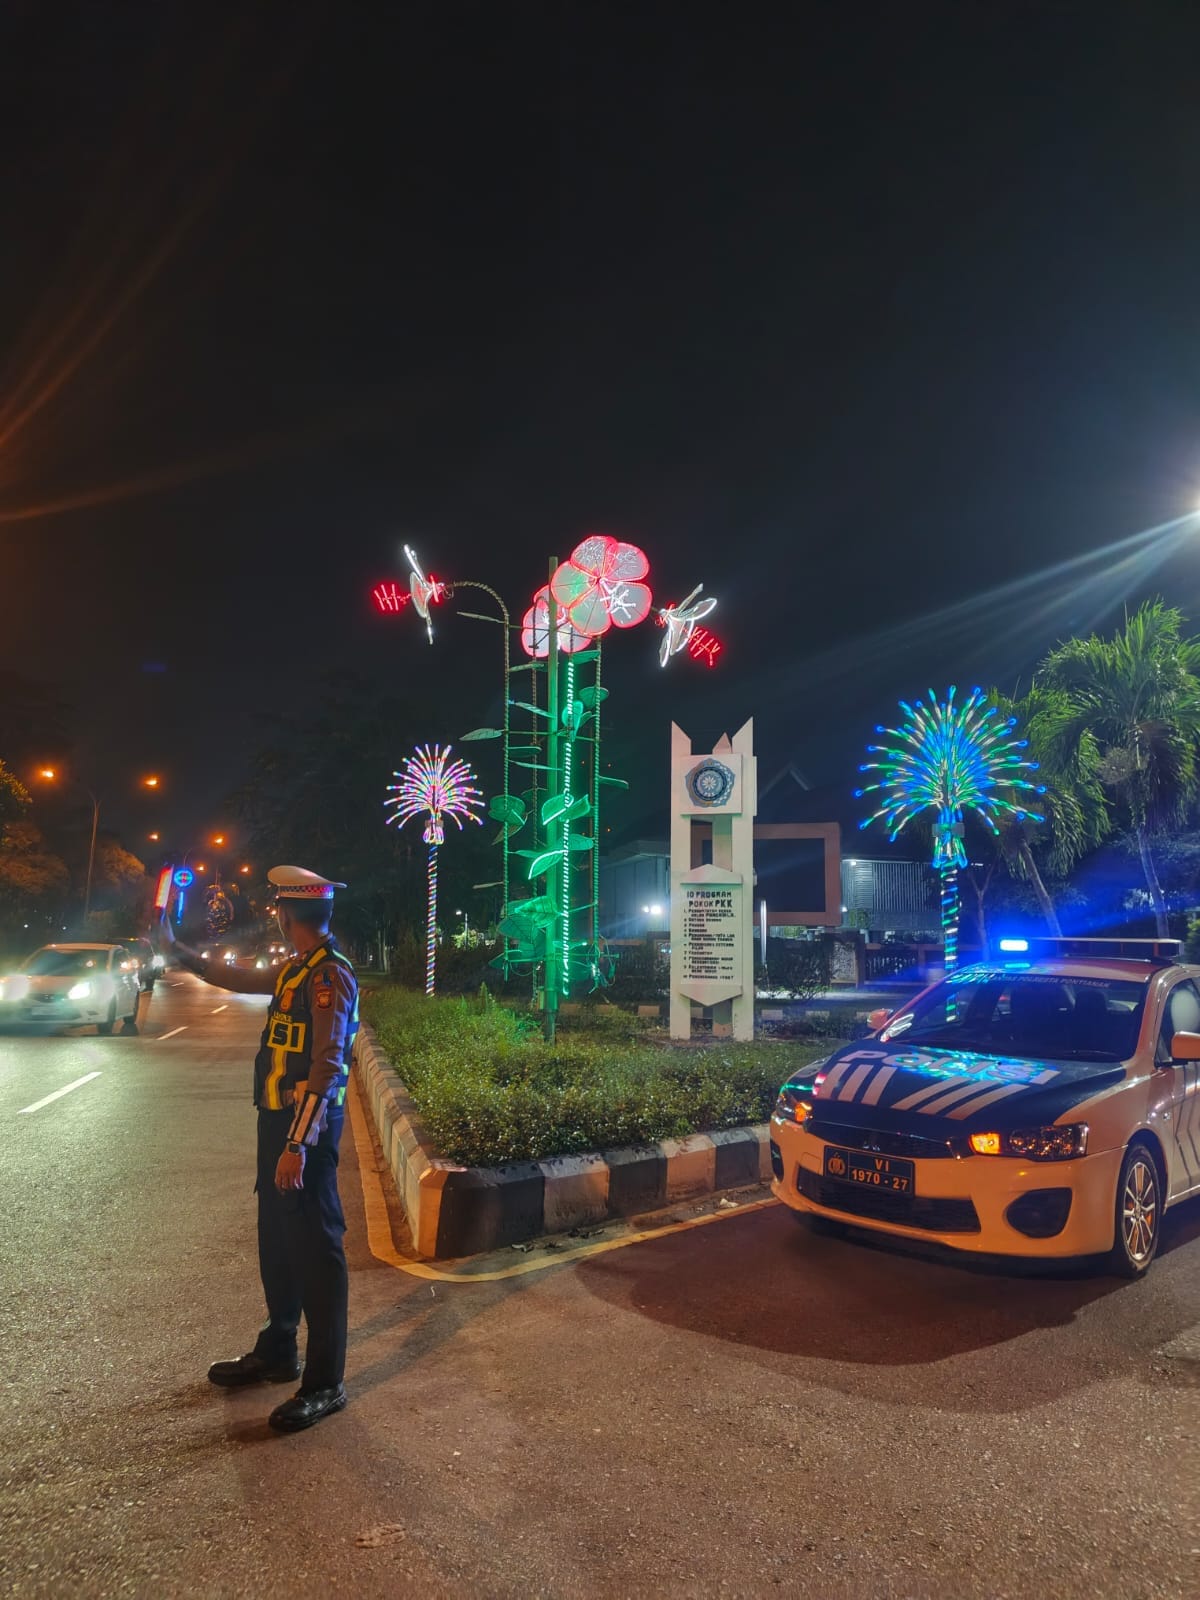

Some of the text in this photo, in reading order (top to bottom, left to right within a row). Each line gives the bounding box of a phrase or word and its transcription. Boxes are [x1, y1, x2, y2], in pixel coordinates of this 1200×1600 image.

[715, 899, 733, 908] PKK
[839, 1050, 1061, 1084] POLISI
[875, 1158, 890, 1172] VI
[852, 1168, 880, 1184] 1970
[892, 1177, 908, 1190] 27
